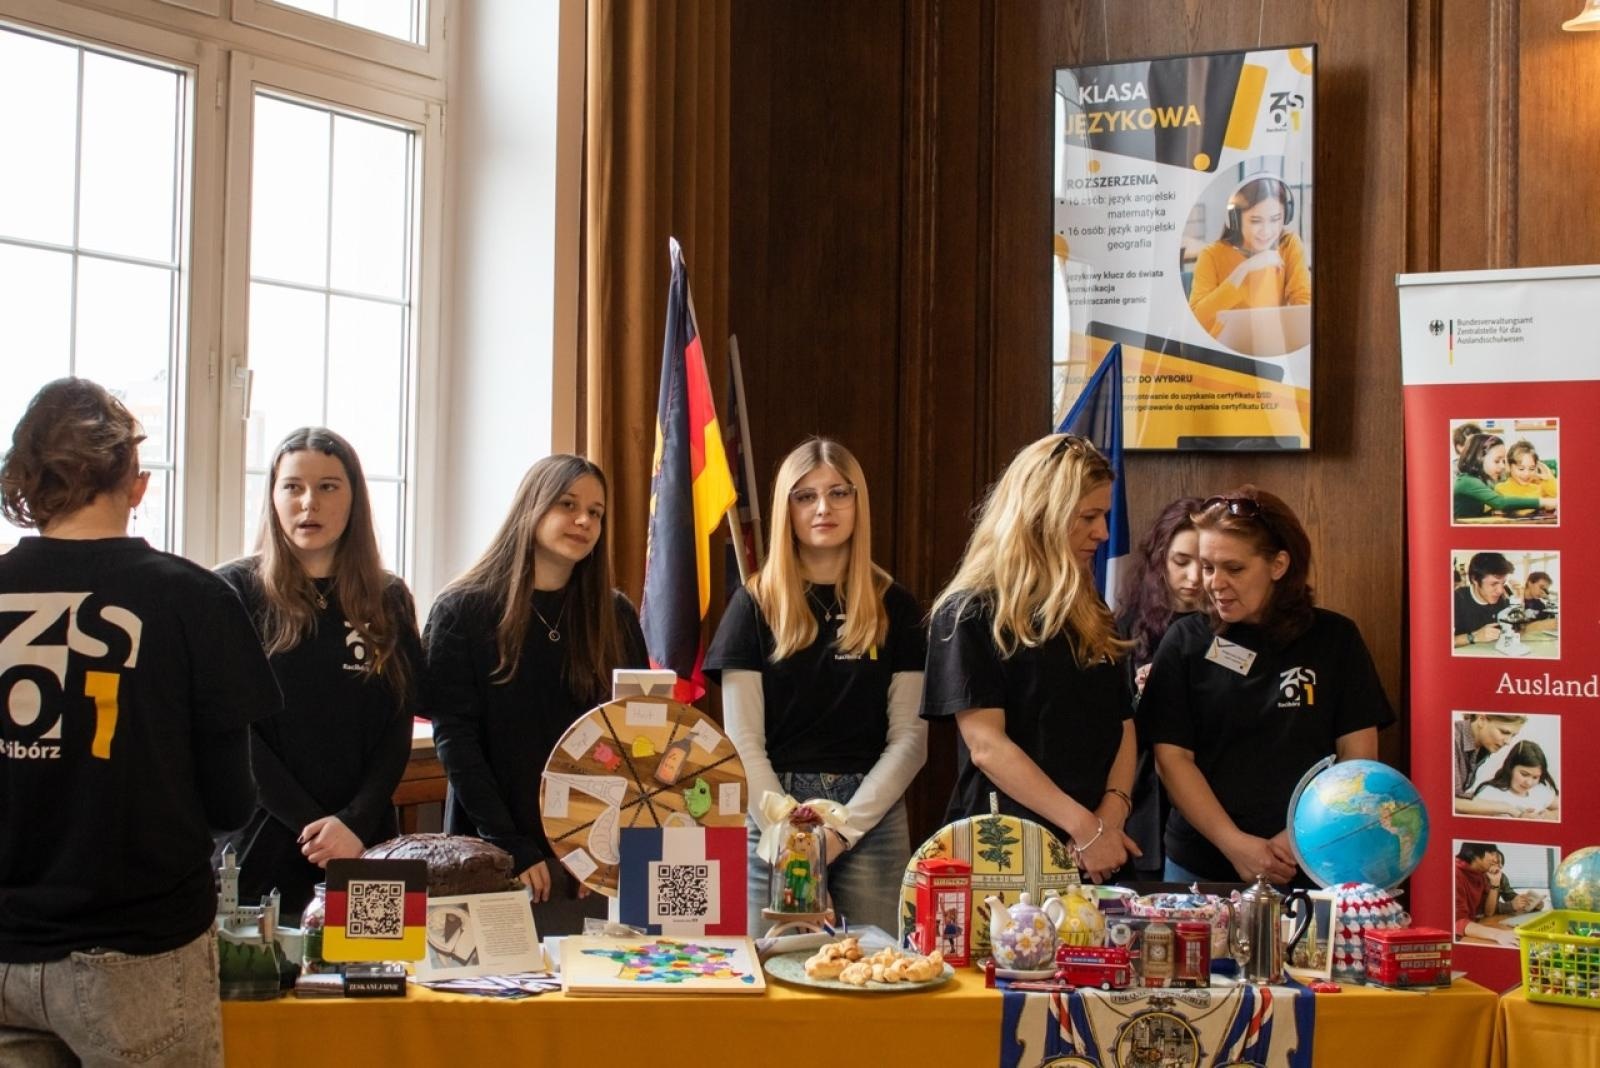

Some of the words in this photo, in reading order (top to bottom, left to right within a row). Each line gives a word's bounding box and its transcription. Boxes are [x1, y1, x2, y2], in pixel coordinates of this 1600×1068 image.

[1079, 81, 1148, 104] KLASA
[1065, 105, 1201, 138] JĘZYKOWA
[1067, 174, 1159, 189] ROZSZERZENIA
[1108, 193, 1132, 206] język
[1135, 191, 1176, 203] angielski
[1108, 208, 1166, 219] matematyka
[1068, 227, 1080, 236] 16
[1108, 224, 1132, 236] język
[1135, 222, 1176, 234] angielski
[1107, 239, 1152, 251] geografia
[1103, 270, 1125, 279] klucz
[1126, 270, 1137, 278] do
[1139, 269, 1164, 278] świata
[1122, 296, 1147, 306] granic
[1457, 317, 1533, 326] Bundesverwaltungsamt
[1457, 327, 1497, 335] Zentralstelle
[1499, 326, 1509, 334] für
[1510, 326, 1522, 334] das
[1139, 375, 1152, 384] DO
[1154, 374, 1193, 384] WYBORU
[1170, 392, 1180, 400] do
[1181, 391, 1216, 401] uzyskania
[1216, 391, 1256, 401] certyfikatu
[1174, 402, 1184, 411] do
[1184, 402, 1220, 412] uzyskania
[1221, 402, 1260, 412] certyfikatu
[1496, 672, 1599, 698] Ausland
